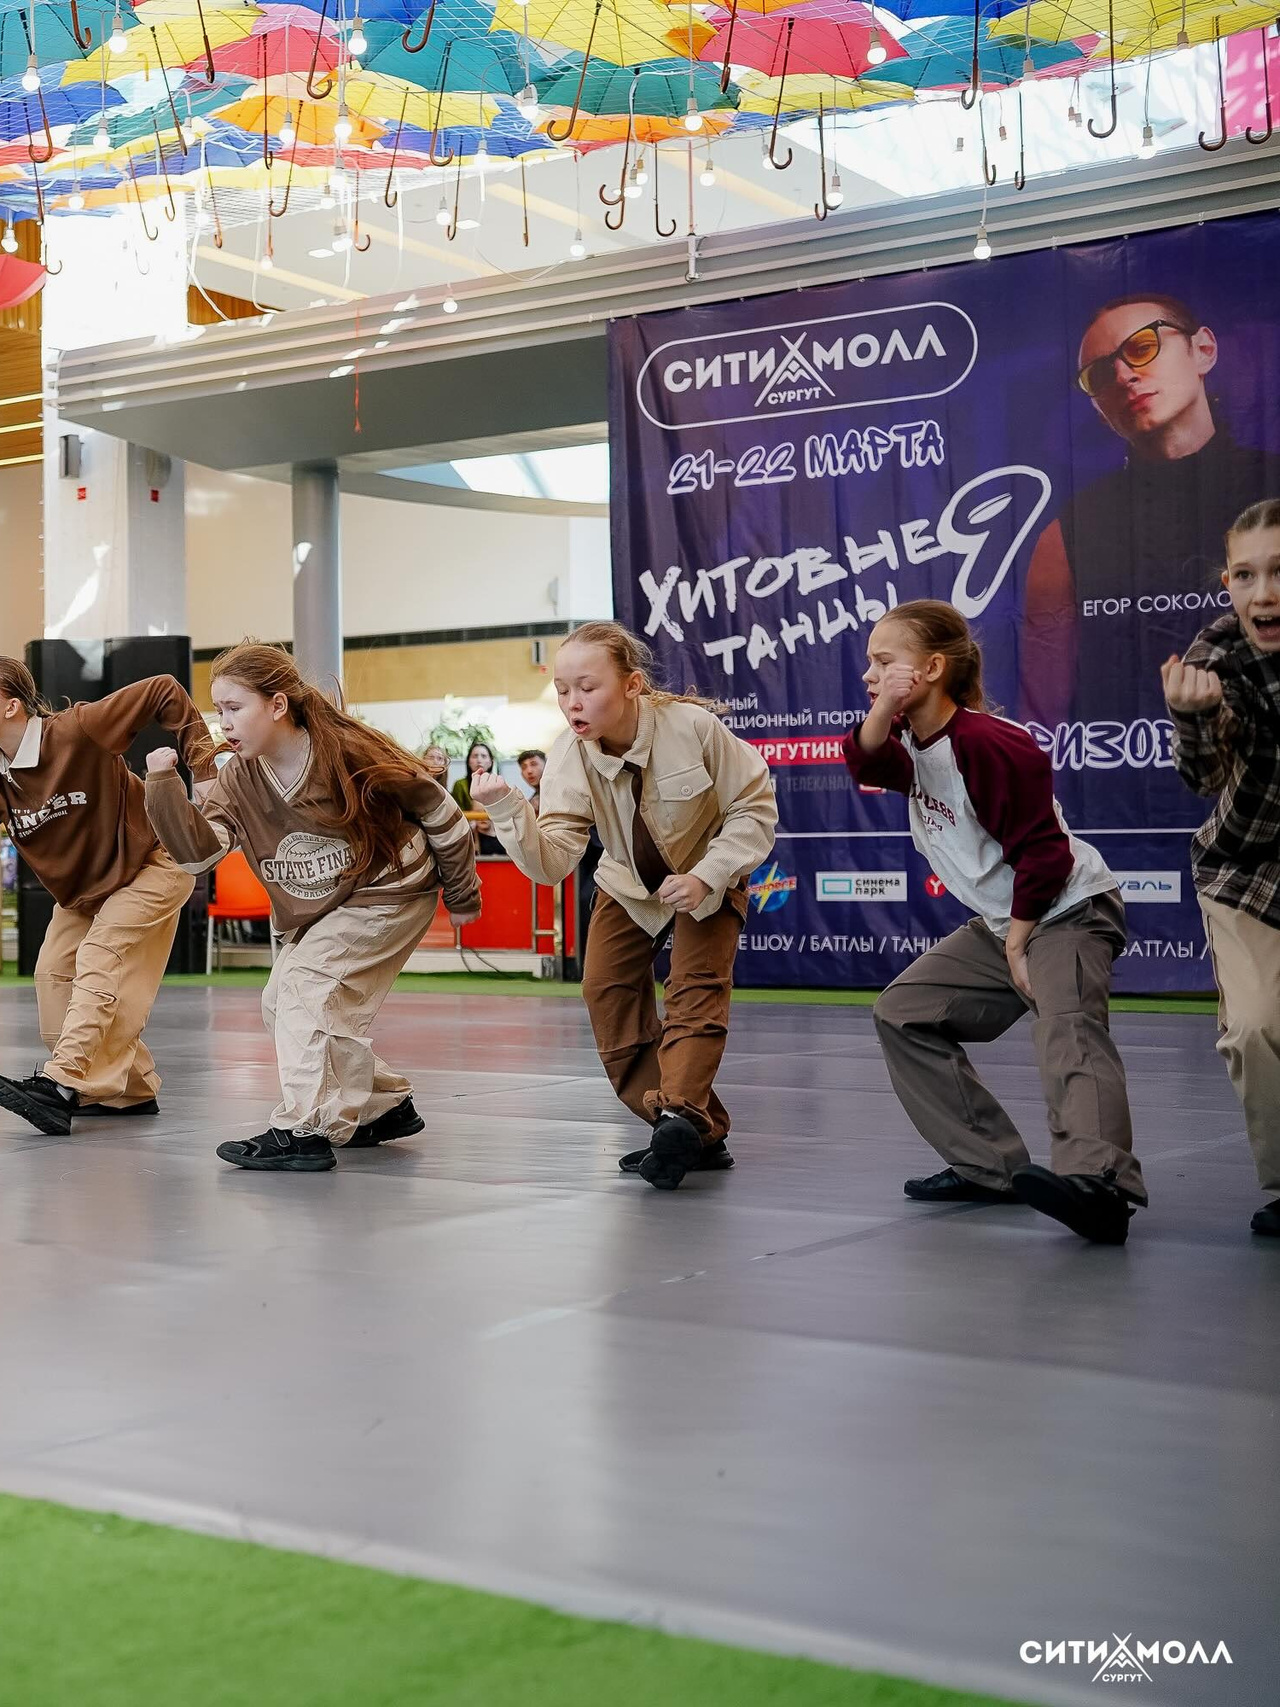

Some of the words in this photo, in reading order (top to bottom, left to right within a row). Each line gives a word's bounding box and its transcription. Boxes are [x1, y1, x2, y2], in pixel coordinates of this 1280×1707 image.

[663, 347, 776, 394] СИТИ
[812, 324, 948, 371] МОЛЛ
[767, 386, 823, 405] СУРГУТ
[667, 441, 797, 495] 21-22
[805, 420, 945, 480] МАРТА
[638, 518, 943, 642] ХИТОВЫЕ
[1083, 597, 1132, 617] ЕГОР
[1137, 591, 1233, 613] СОКОЛО
[704, 580, 899, 675] ТАНЦЫ
[264, 860, 316, 881] STATE
[855, 878, 900, 887] синема
[855, 887, 885, 896] парк
[751, 933, 794, 952] ШОУ
[810, 934, 874, 953] БАТТЛЫ
